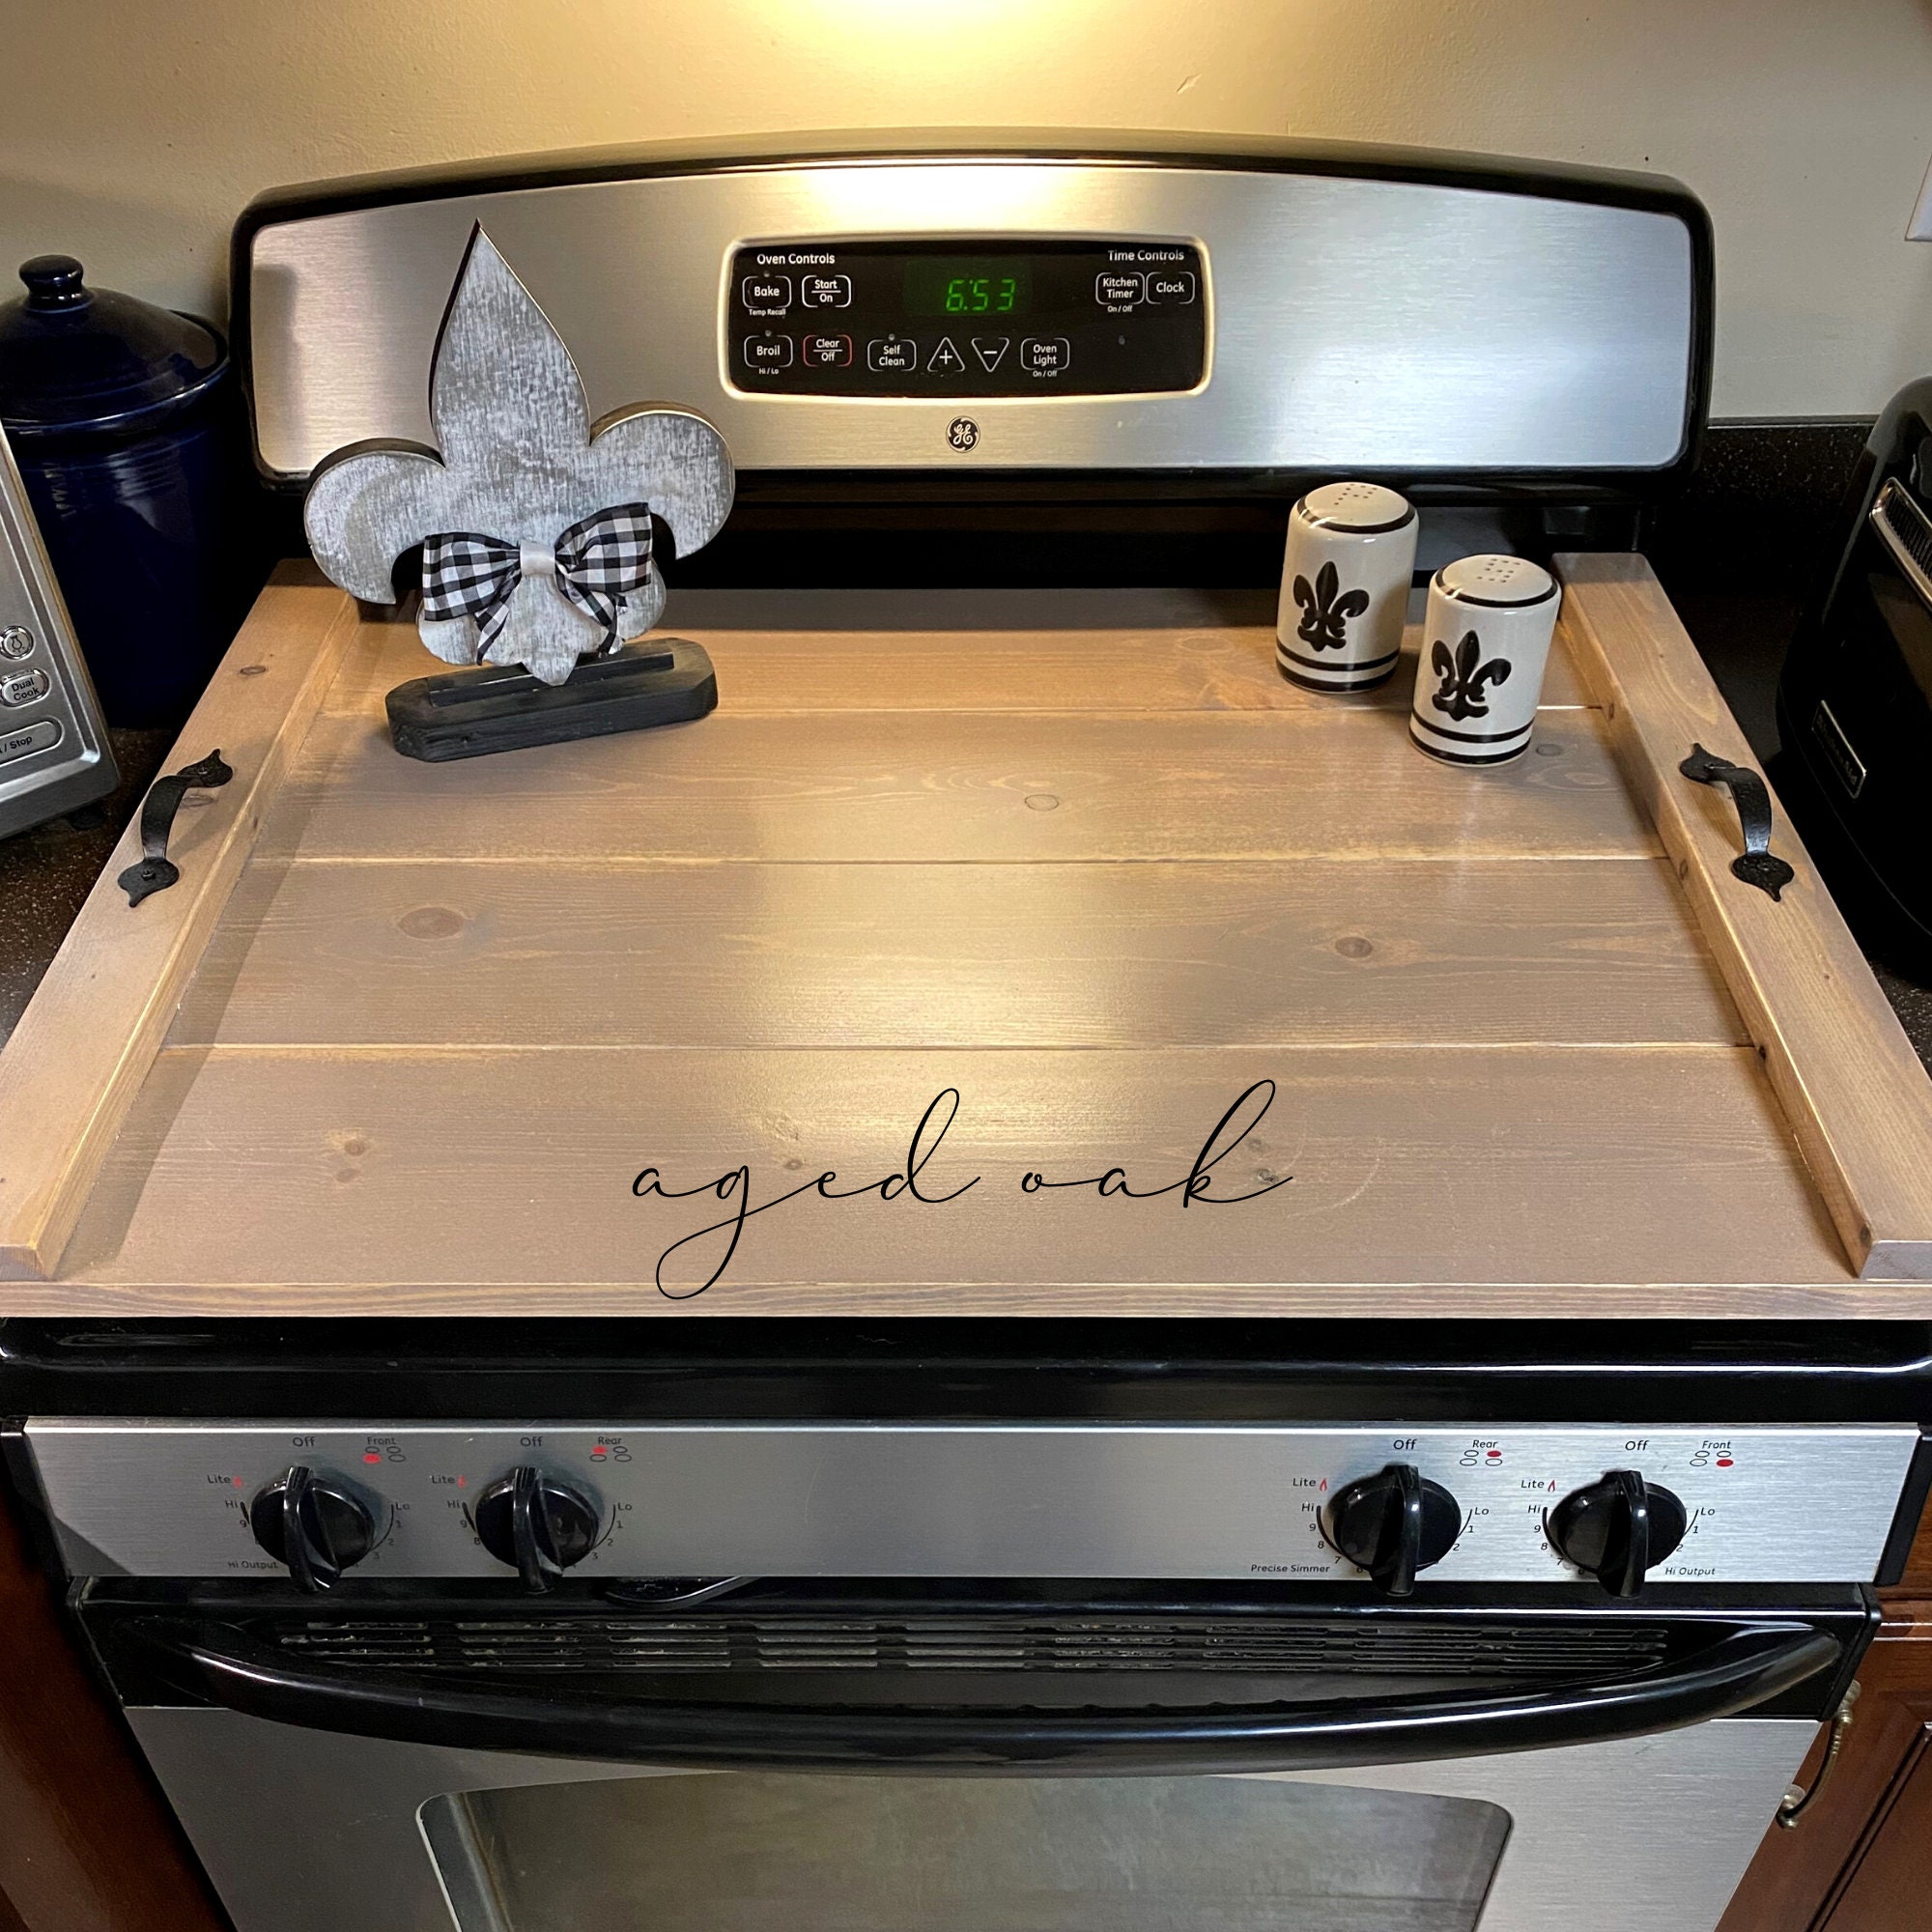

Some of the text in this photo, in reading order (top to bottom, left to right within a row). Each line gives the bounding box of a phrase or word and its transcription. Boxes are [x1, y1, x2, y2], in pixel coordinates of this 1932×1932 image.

[756, 252, 836, 265] Oven Controls
[1108, 249, 1184, 261] Time Controls
[814, 279, 838, 290] Start
[1102, 277, 1138, 288] Kitchen
[1156, 281, 1184, 293] Clock
[753, 286, 780, 297] Bake
[946, 278, 1016, 312] 6:53
[1107, 289, 1134, 298] Timer
[819, 293, 834, 303] On
[816, 338, 839, 349] Clear
[756, 345, 781, 355] Broil
[883, 346, 900, 355] Self
[1033, 344, 1058, 354] Oven
[821, 352, 836, 361] Off
[878, 356, 905, 366] Clean
[1034, 355, 1057, 367] Light
[12, 677, 35, 693] Dual
[14, 687, 40, 701] Cook
[10, 736, 33, 750] Stop
[292, 1436, 315, 1448] Off
[367, 1436, 396, 1446] Front
[520, 1436, 544, 1447] Off
[598, 1436, 622, 1445] Rear
[1393, 1438, 1417, 1450] Off
[1472, 1439, 1498, 1448] Rear
[1625, 1440, 1650, 1451] Off
[1702, 1440, 1731, 1450] Front
[207, 1475, 232, 1485] Lite
[431, 1475, 455, 1485] Lite
[1293, 1478, 1317, 1488] Lite
[1520, 1479, 1545, 1489] Lite
[225, 1500, 239, 1509] Hi
[395, 1502, 410, 1511] Lo
[447, 1500, 460, 1509] Hi
[617, 1502, 633, 1511] Lo
[1301, 1503, 1315, 1513] Hi
[1527, 1504, 1542, 1514] Hi
[1474, 1506, 1490, 1516] Lo
[1700, 1507, 1716, 1516] Lo
[460, 1520, 468, 1528] 9
[1309, 1523, 1317, 1532] 9
[1533, 1524, 1541, 1533] 9
[1467, 1525, 1474, 1534] 1
[1692, 1525, 1699, 1534] 1
[1318, 1541, 1324, 1549] 8
[1452, 1543, 1460, 1551] 2
[1541, 1542, 1548, 1550] 8
[1334, 1555, 1342, 1564] 7
[1556, 1557, 1564, 1566] 7
[242, 1560, 278, 1570] Output
[1251, 1564, 1330, 1573] Precise Simmer
[1679, 1567, 1716, 1577] Output
